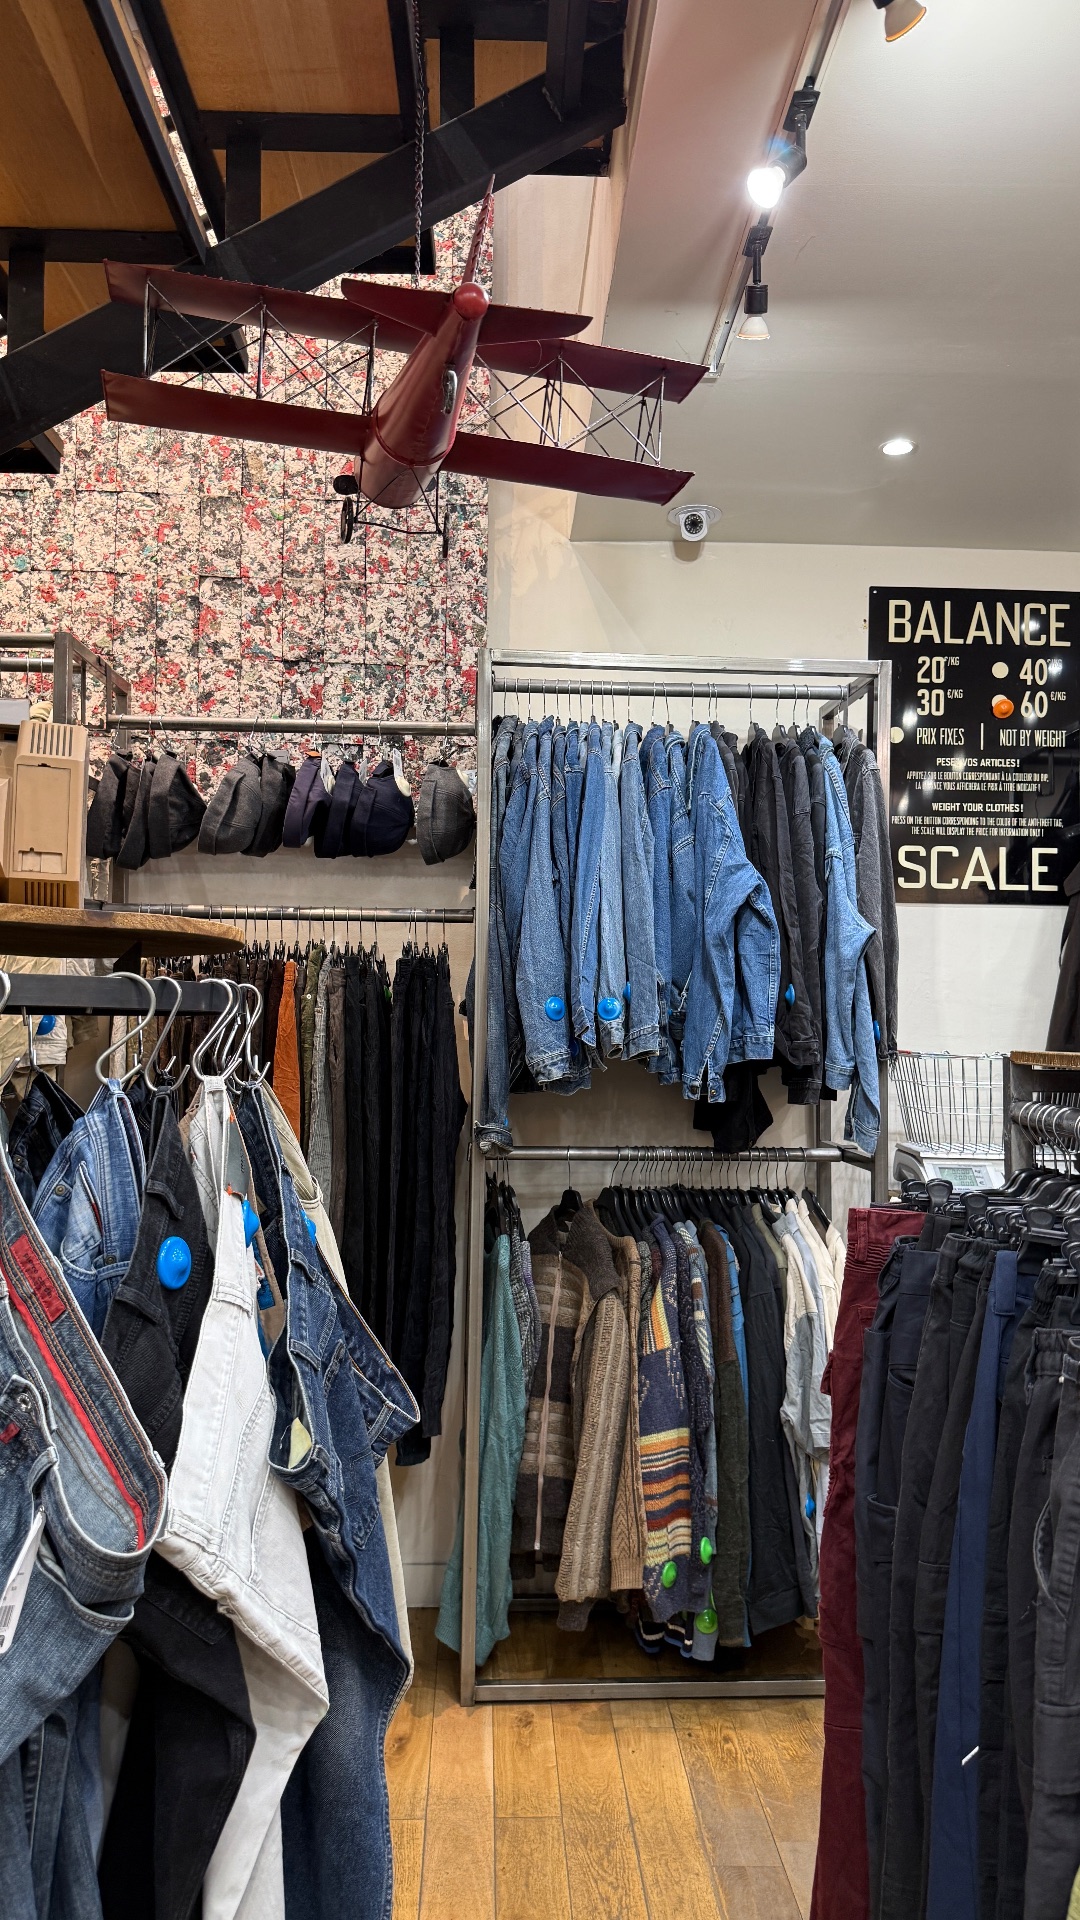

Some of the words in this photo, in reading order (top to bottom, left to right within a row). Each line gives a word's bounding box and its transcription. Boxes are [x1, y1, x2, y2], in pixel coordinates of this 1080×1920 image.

[888, 599, 1071, 647] BALANCE
[917, 656, 945, 683] 20
[1019, 658, 1048, 685] 40
[916, 689, 944, 716] 30
[947, 689, 964, 699] €/KG
[1020, 691, 1048, 718] 60
[1050, 691, 1067, 701] €/KG
[916, 727, 937, 745] PRIX
[939, 728, 965, 746] FIXES
[999, 729, 1017, 746] NOT
[1020, 730, 1031, 746] BY
[1034, 730, 1067, 748] WEIGHT
[906, 771, 927, 780] APPUYEZ
[938, 771, 943, 780] LE
[1006, 773, 1012, 782] LA
[915, 781, 922, 790] LA
[943, 782, 956, 791] VOUS
[931, 802, 961, 812] WEIGHT
[962, 803, 984, 812] YOUR
[891, 815, 906, 825] PRESS
[906, 816, 914, 825] ON
[914, 816, 923, 825] THE
[979, 817, 986, 826] TO
[987, 817, 995, 826] THE
[1011, 818, 1018, 827] OF
[1018, 818, 1027, 827] THE
[911, 826, 920, 835] THE
[935, 827, 946, 836] WILL
[966, 827, 975, 836] THE
[975, 828, 988, 837] PRICE
[989, 828, 998, 837] FOR
[897, 844, 1059, 892] SCALE
